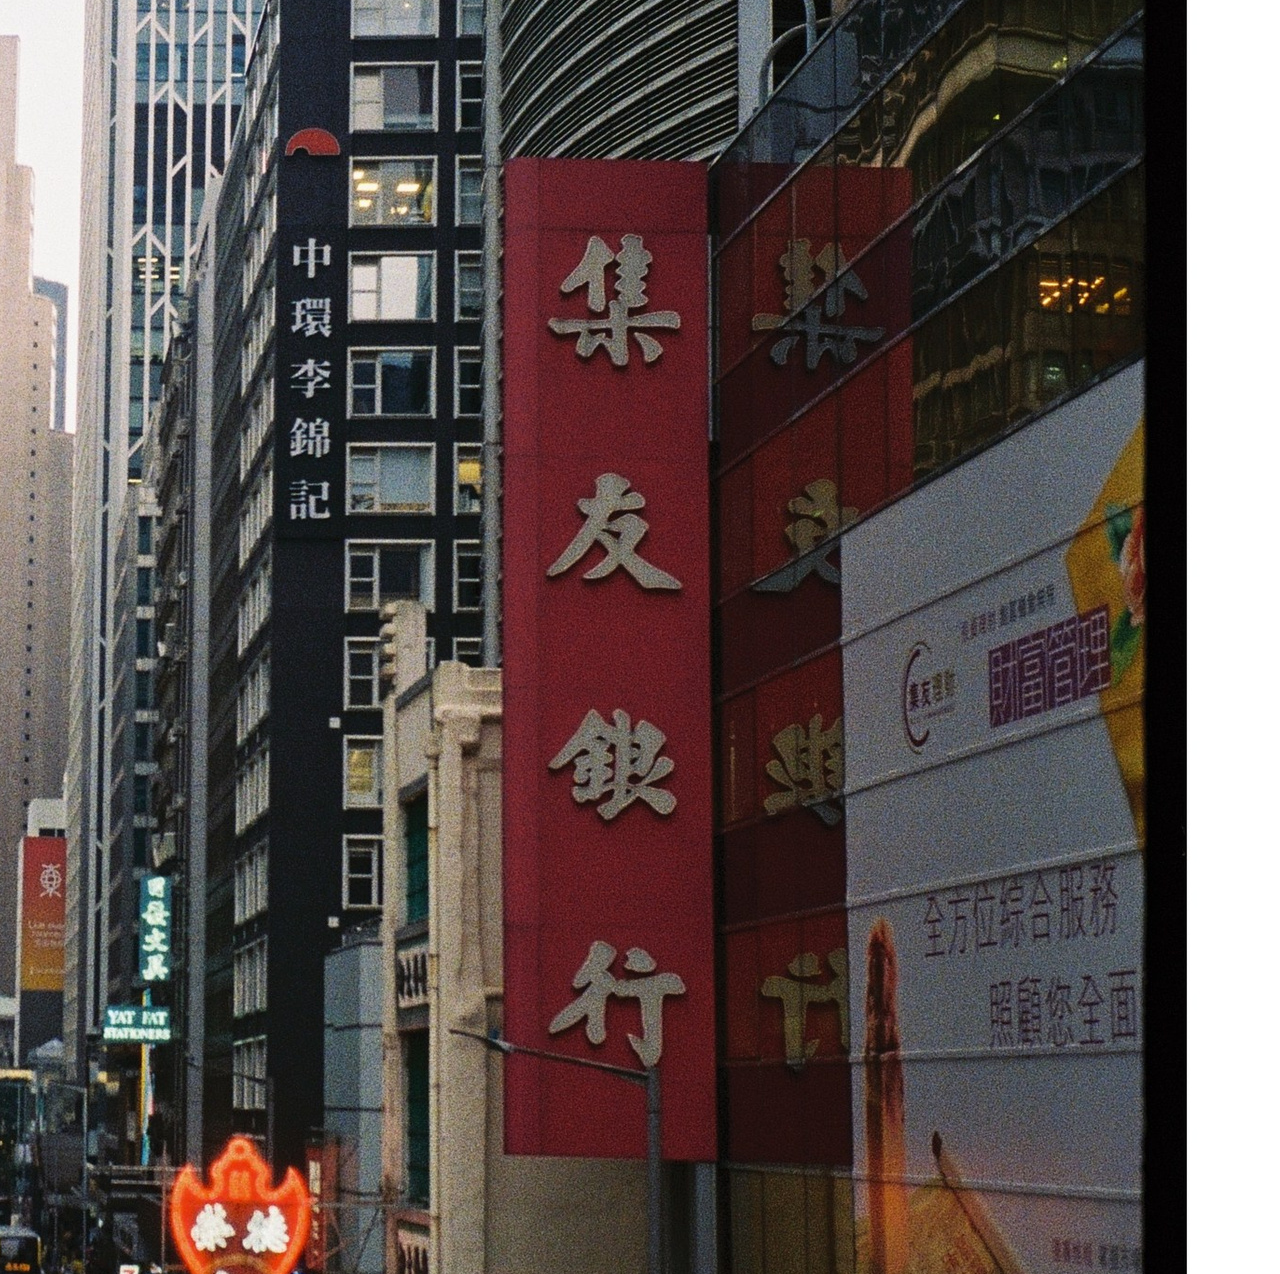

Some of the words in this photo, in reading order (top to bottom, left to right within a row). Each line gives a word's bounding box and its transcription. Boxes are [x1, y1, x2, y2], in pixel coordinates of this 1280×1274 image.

[289, 237, 333, 521] 中環李錦記
[547, 233, 686, 1069] 集友銀行
[990, 609, 1111, 727] 財富管理
[923, 861, 1118, 958] 全方位綜合服務
[103, 1027, 170, 1040] STATIONERS
[107, 1009, 135, 1025] YAT
